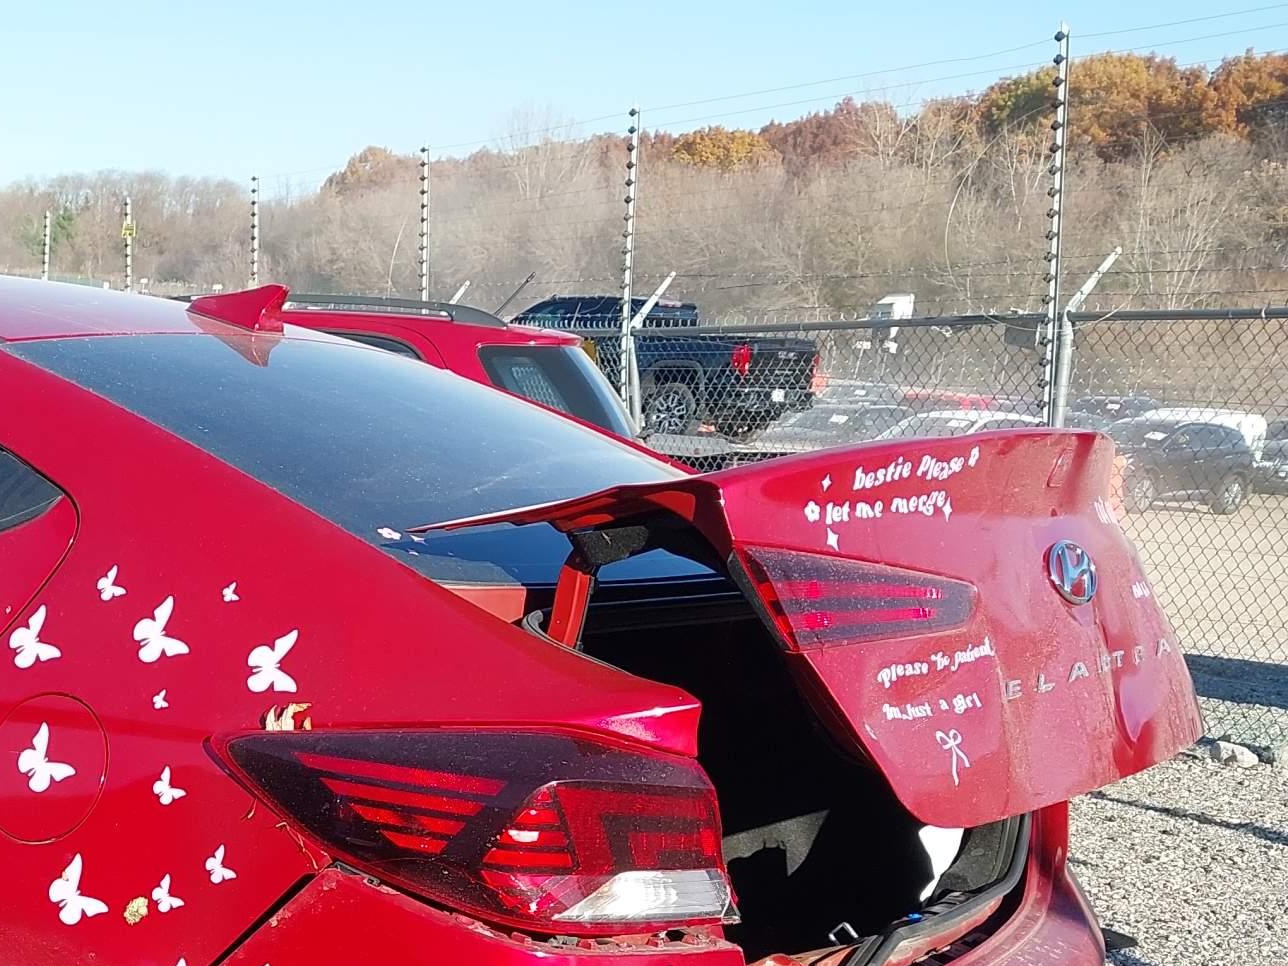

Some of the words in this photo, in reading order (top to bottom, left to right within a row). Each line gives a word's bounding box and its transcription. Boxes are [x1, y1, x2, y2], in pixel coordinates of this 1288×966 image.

[853, 456, 912, 491] bestie
[825, 501, 850, 525] let
[855, 500, 884, 519] me
[890, 490, 946, 517] merge
[951, 636, 996, 671] patient
[939, 698, 950, 711] a
[952, 692, 982, 714] girl
